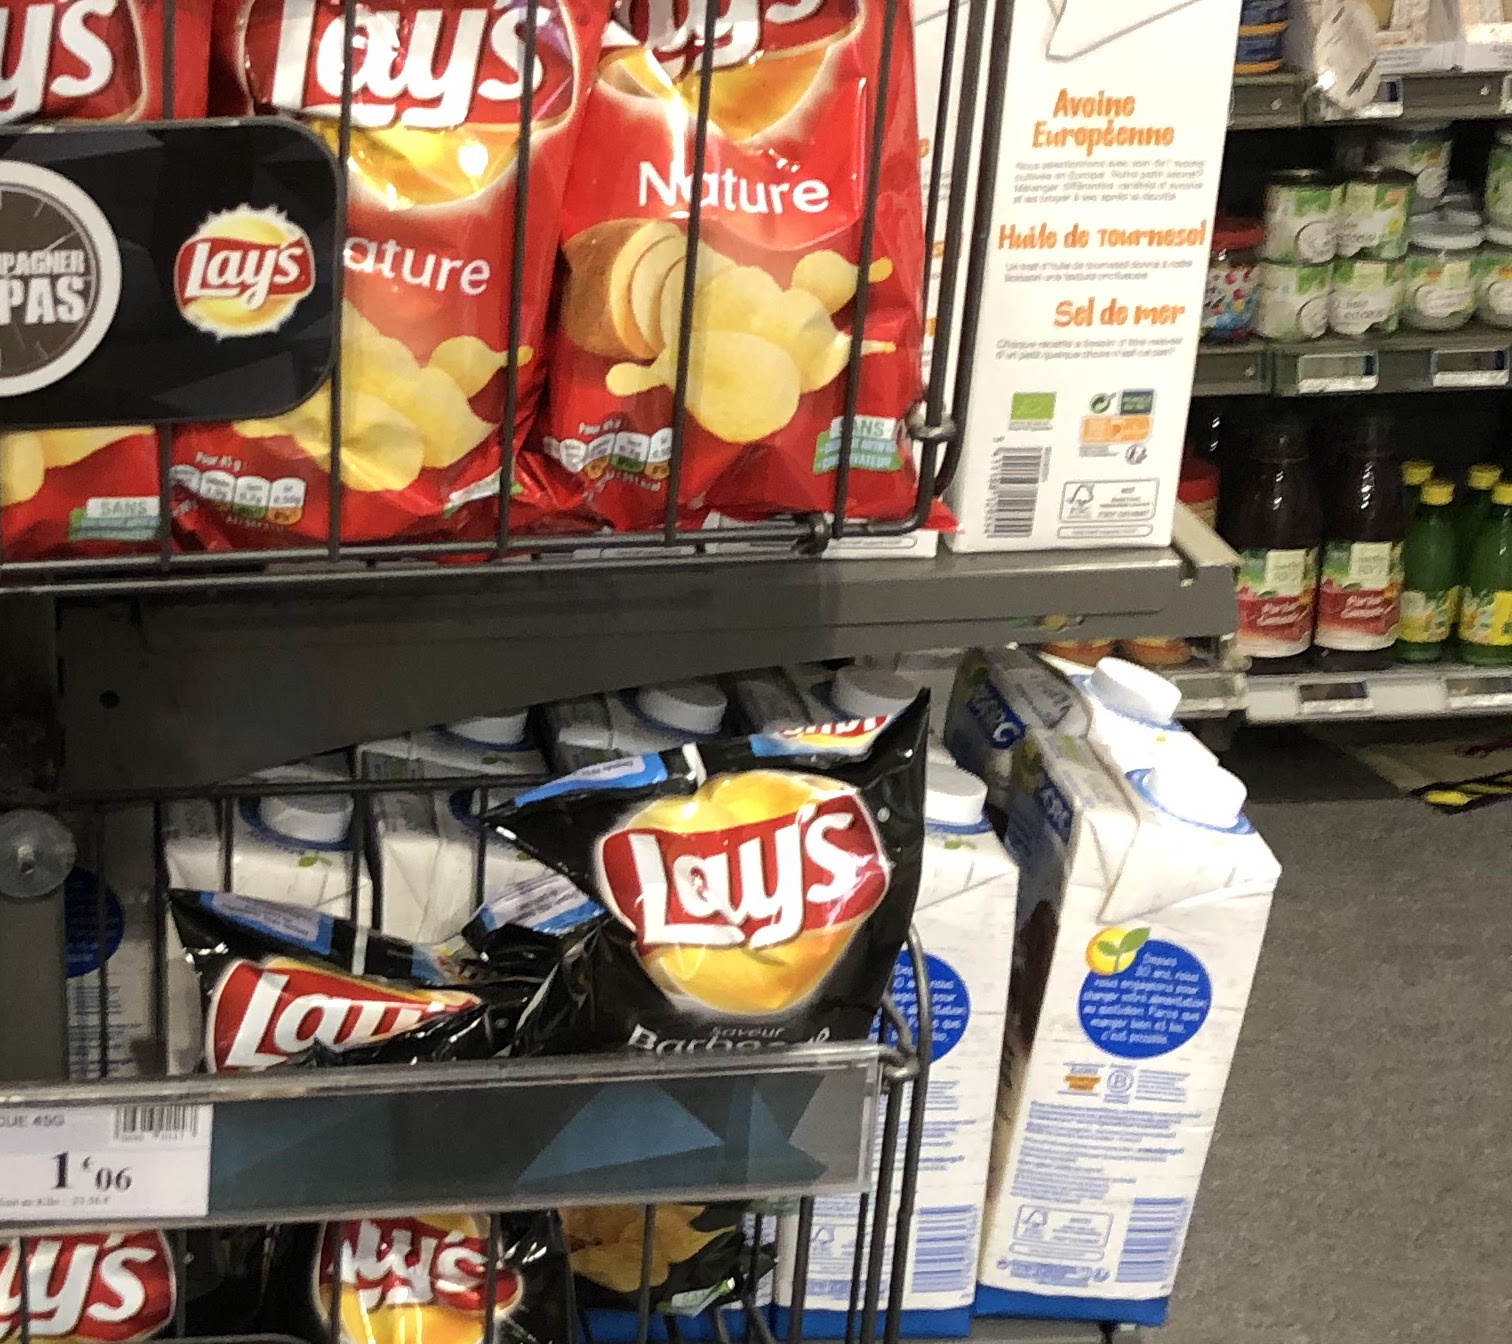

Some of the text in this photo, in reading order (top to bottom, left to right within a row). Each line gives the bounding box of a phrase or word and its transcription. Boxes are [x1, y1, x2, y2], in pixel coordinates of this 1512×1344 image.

[1053, 88, 1136, 118] Avoine
[1032, 120, 1175, 157] Européenne
[638, 162, 830, 215] Nature
[998, 222, 1058, 250] Huile
[1063, 223, 1090, 248] de
[186, 240, 305, 310] Lay's
[344, 235, 491, 297] ature
[1053, 296, 1185, 329] Sel de mer
[629, 801, 854, 948] Lay's
